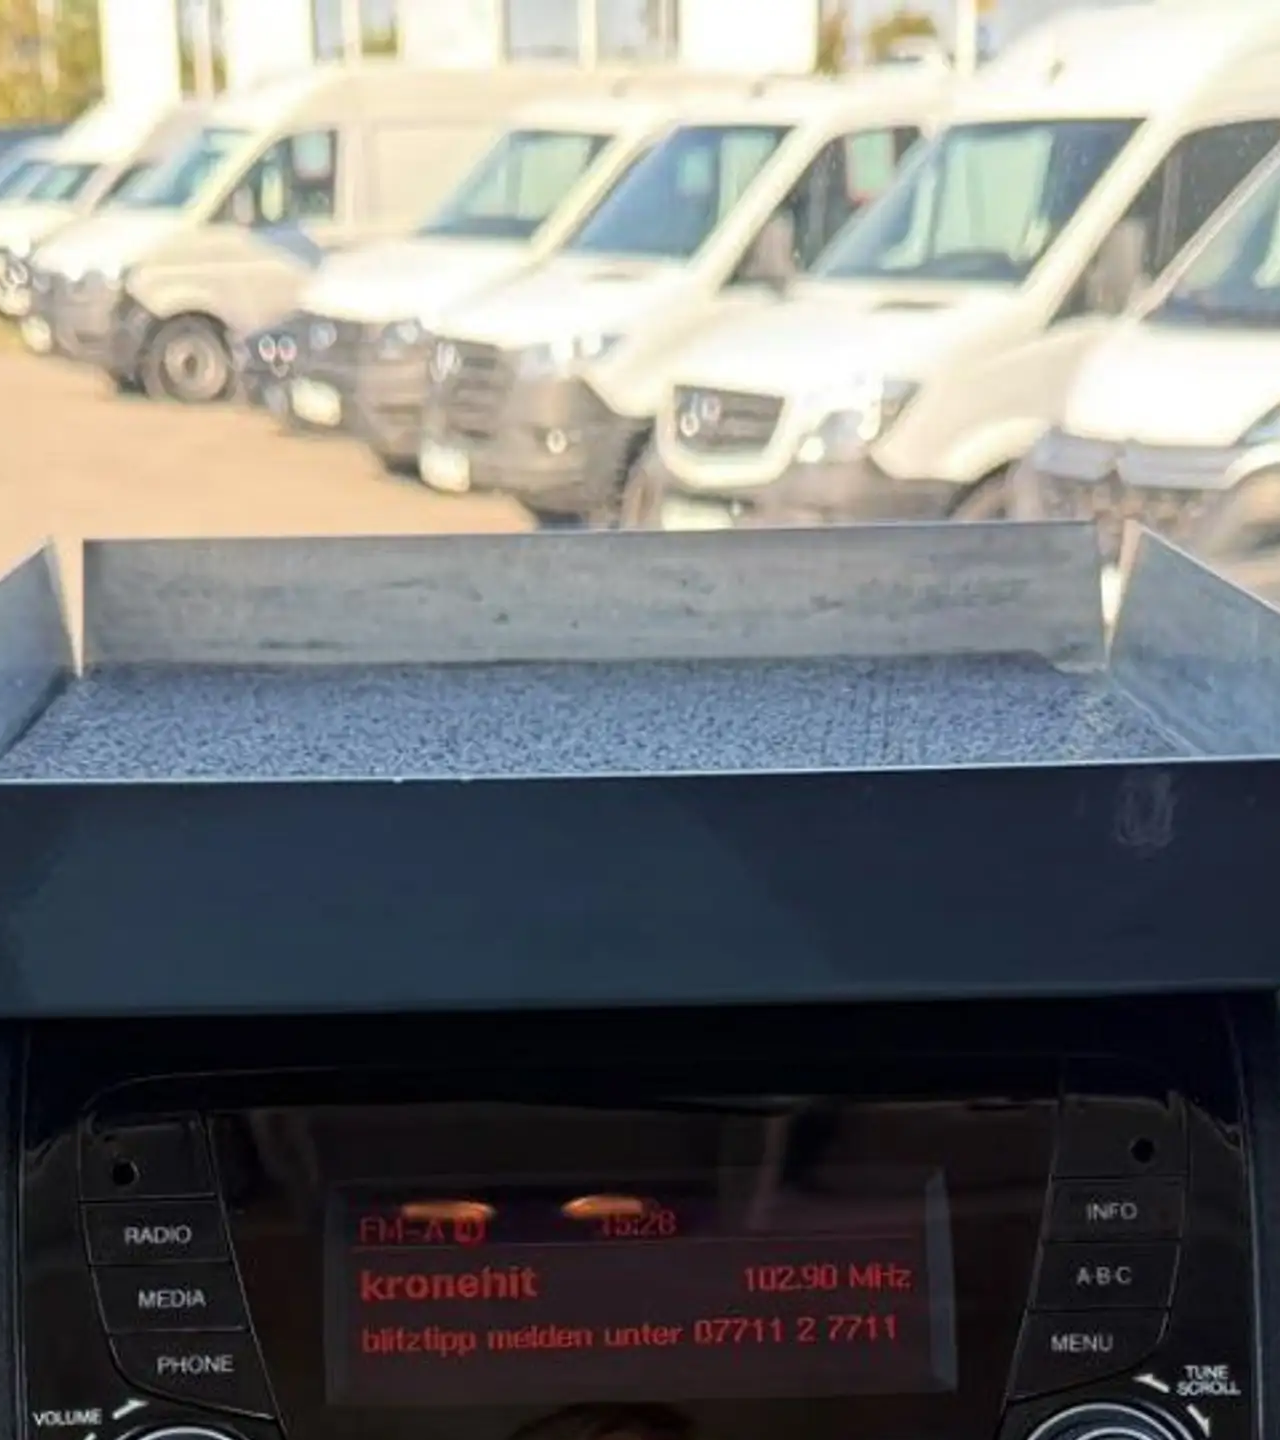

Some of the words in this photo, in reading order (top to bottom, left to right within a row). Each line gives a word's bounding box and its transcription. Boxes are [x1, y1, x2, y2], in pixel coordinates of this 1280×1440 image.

[1087, 1202, 1138, 1221] INFO
[124, 1225, 193, 1245] RADIO
[360, 1266, 538, 1300] kronehit
[848, 1264, 913, 1289] MHz
[138, 1289, 207, 1309] MEDIA
[487, 1323, 593, 1349] melden
[604, 1321, 683, 1347] unter
[693, 1317, 783, 1345] 07711
[796, 1316, 817, 1343] 2
[827, 1314, 898, 1342] 7711
[1050, 1333, 1115, 1353] MENU
[157, 1355, 235, 1376] PHONE
[1184, 1365, 1230, 1380] TUNE
[1176, 1380, 1242, 1396] SCROLL
[33, 1408, 102, 1426] VOLUME
